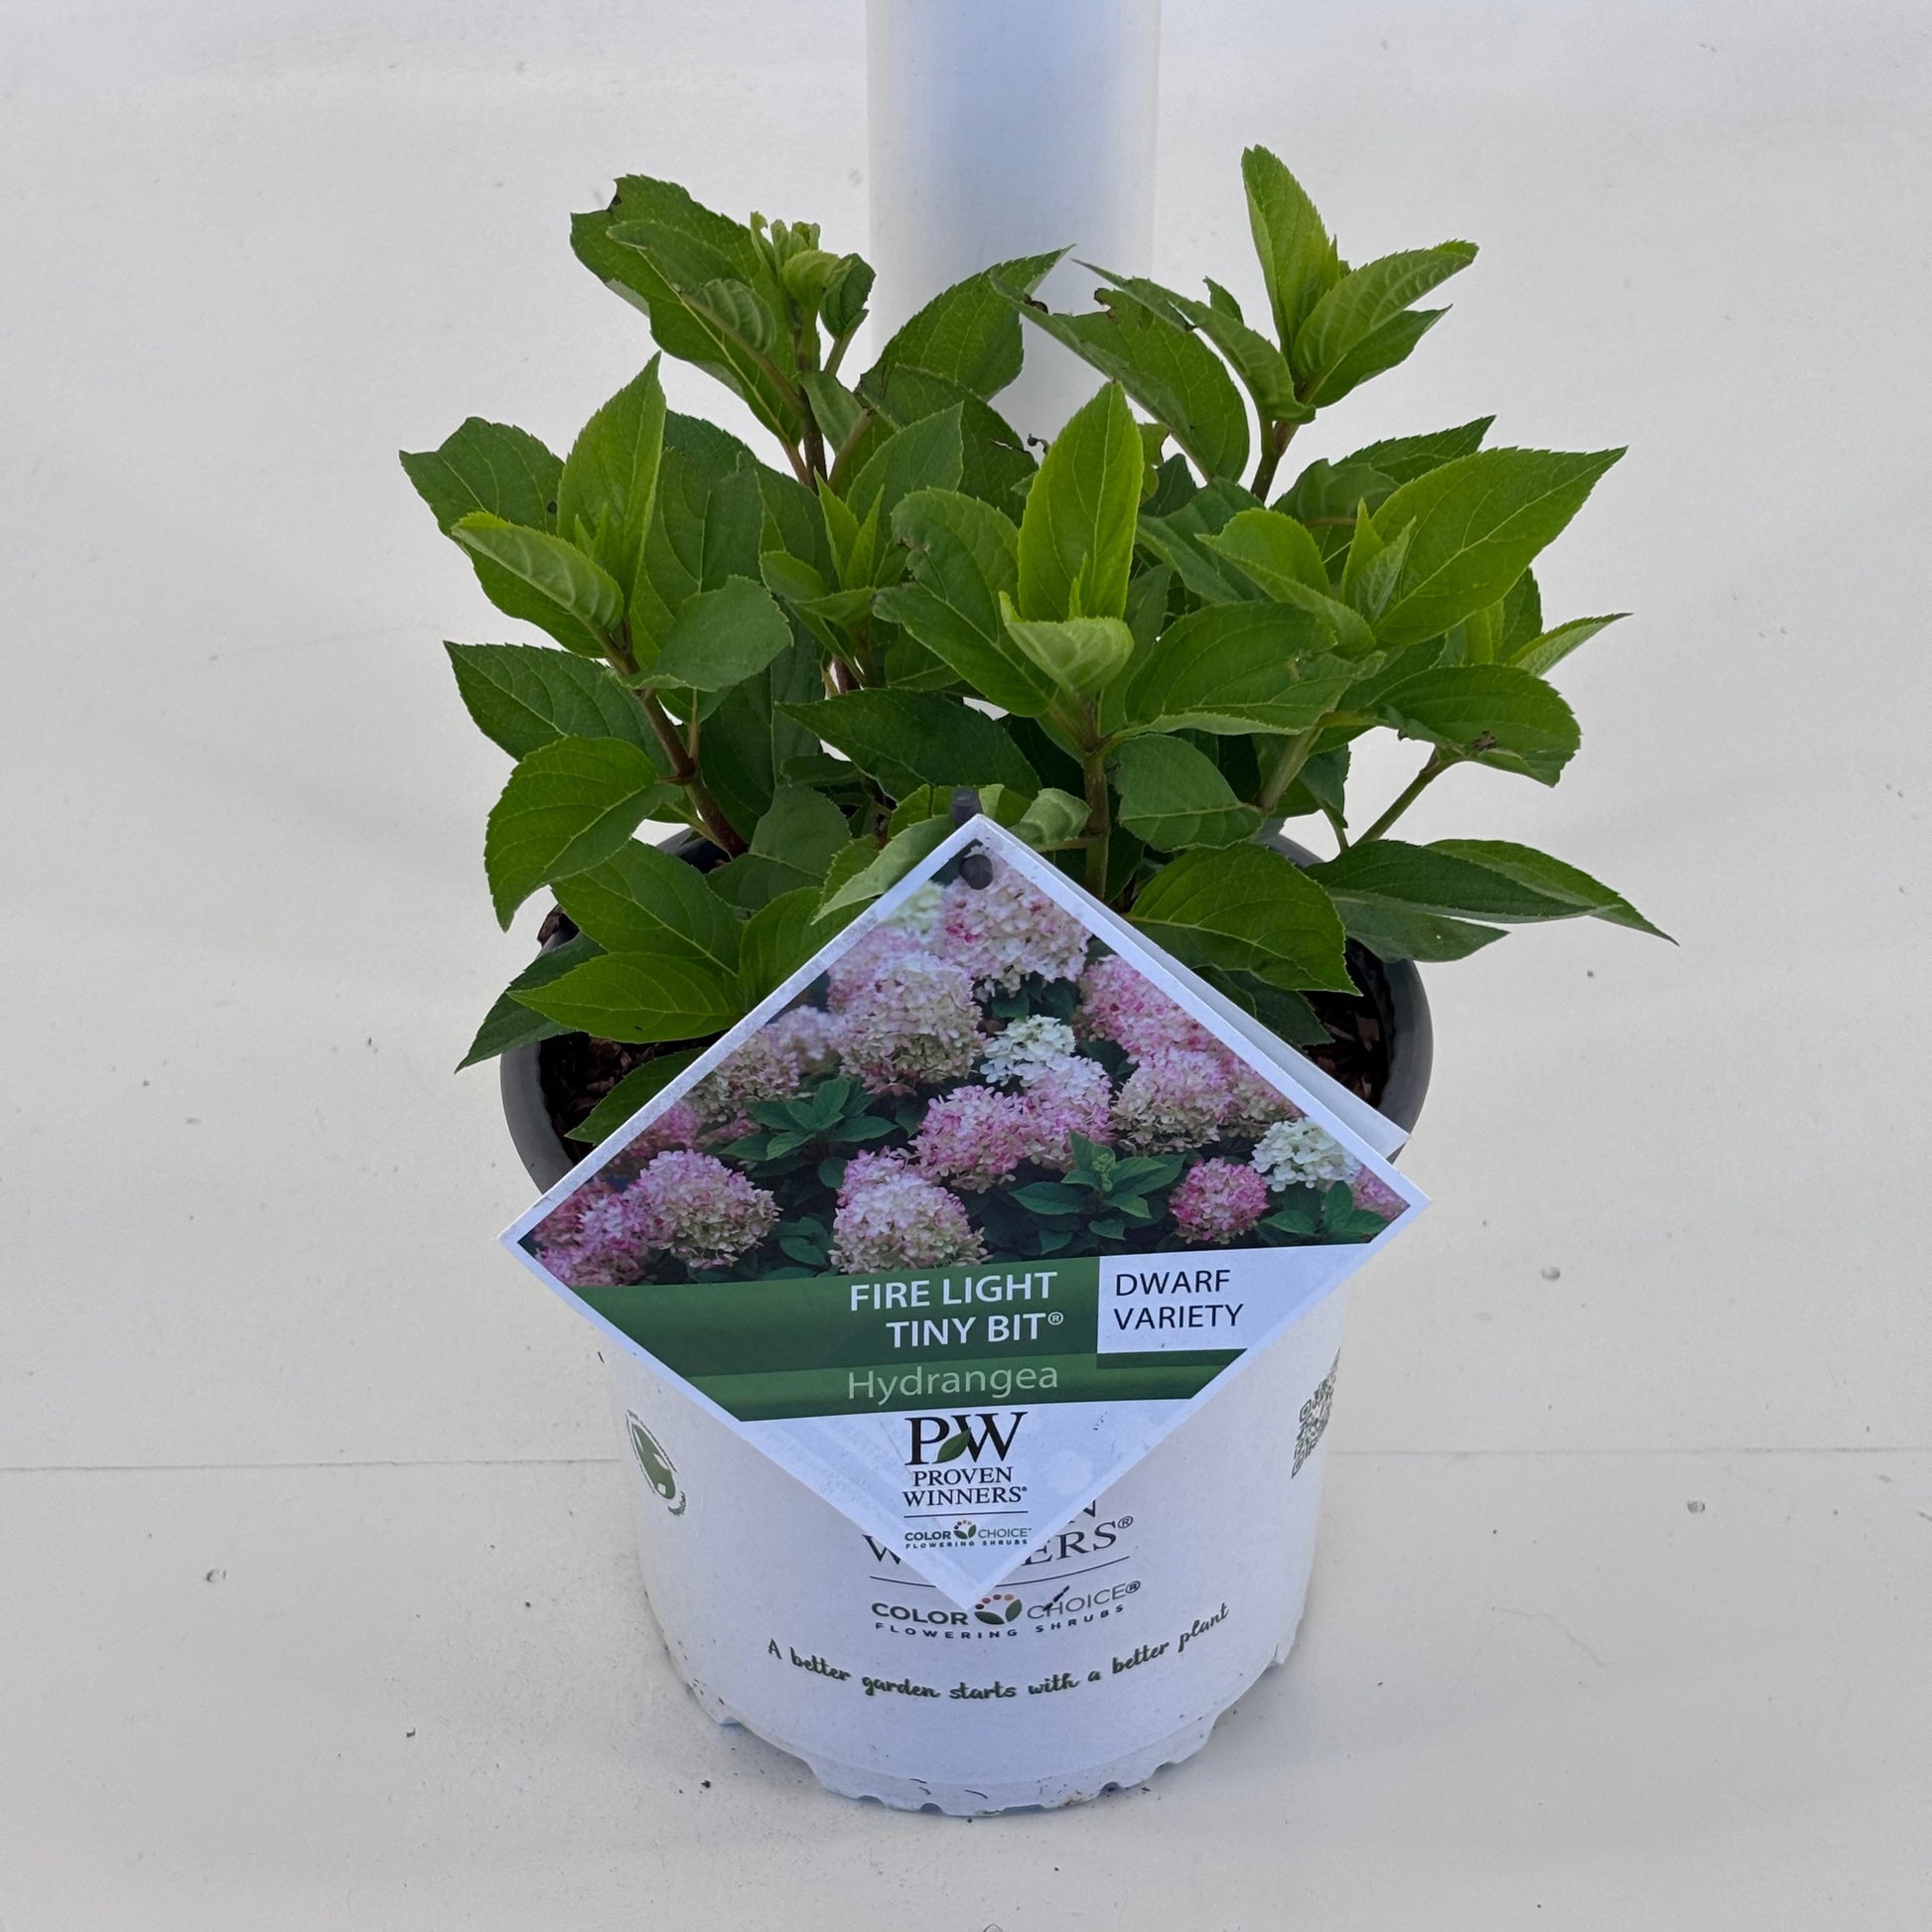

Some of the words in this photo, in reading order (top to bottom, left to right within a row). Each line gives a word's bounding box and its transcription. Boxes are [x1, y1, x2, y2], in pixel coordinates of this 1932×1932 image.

[851, 1280, 930, 1311] FIRE
[942, 1272, 1058, 1307] LIGHT
[1115, 1269, 1232, 1297] DWARF
[1113, 1303, 1244, 1331] VARIETY
[886, 1316, 974, 1348] TINY
[848, 1365, 1058, 1406] Hydrangea
[912, 1466, 1014, 1487] PROVEN
[903, 1530, 952, 1542] COLOR
[904, 1541, 975, 1550] FLOWERING
[871, 1602, 969, 1626] COLOR
[875, 1622, 1018, 1639] FLOWERING
[1035, 1604, 1124, 1633] SHRUBS
[767, 1638, 782, 1660] A
[790, 1646, 852, 1681] better
[861, 1675, 941, 1697] garden
[949, 1681, 1017, 1699] starts
[1028, 1672, 1080, 1696] with
[1087, 1671, 1102, 1682] a
[1112, 1641, 1170, 1674] better
[1177, 1602, 1230, 1653] plant
